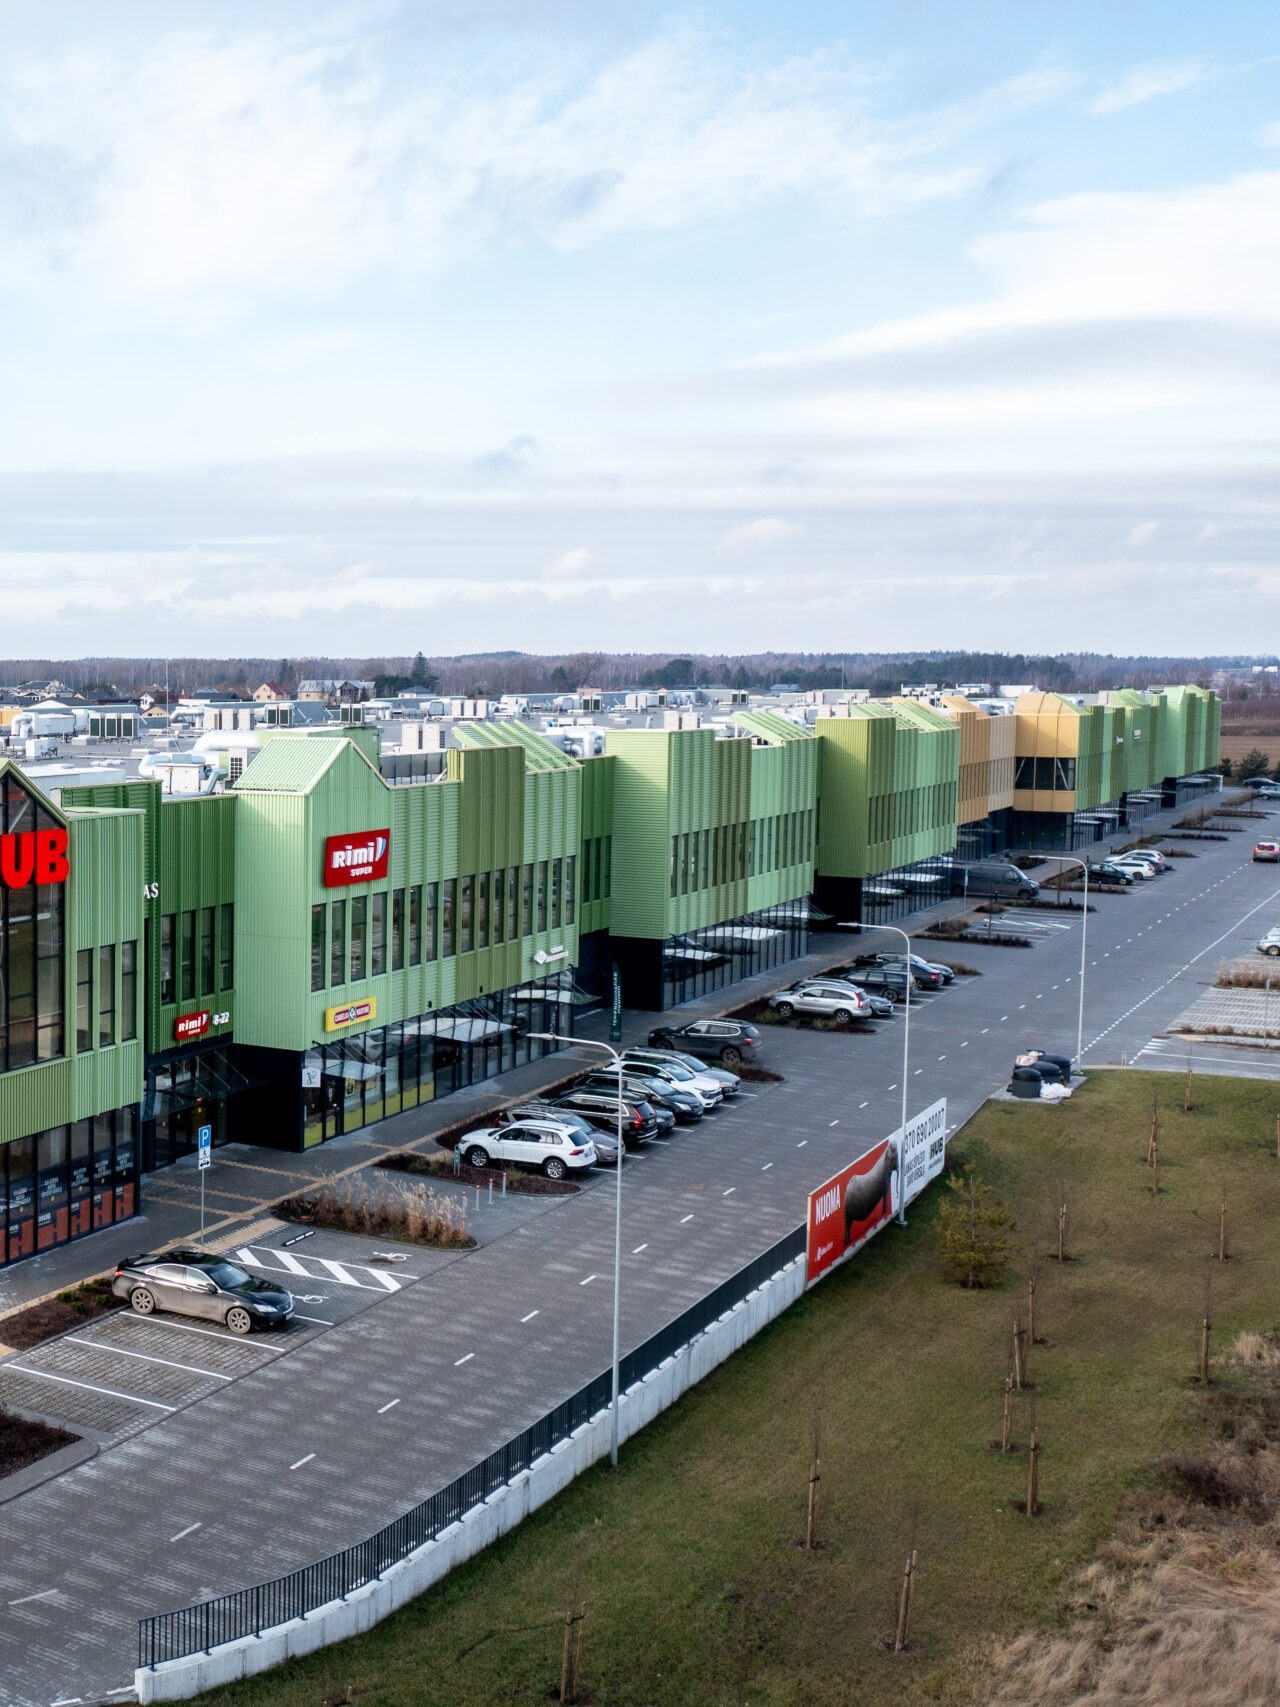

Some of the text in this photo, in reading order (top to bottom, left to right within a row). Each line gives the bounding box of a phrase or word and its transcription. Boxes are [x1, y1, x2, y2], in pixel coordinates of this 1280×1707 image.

[332, 842, 374, 868] Rimi
[350, 866, 372, 876] SUPER
[178, 1016, 201, 1032] Rimi
[816, 1184, 840, 1226] NUOMA
